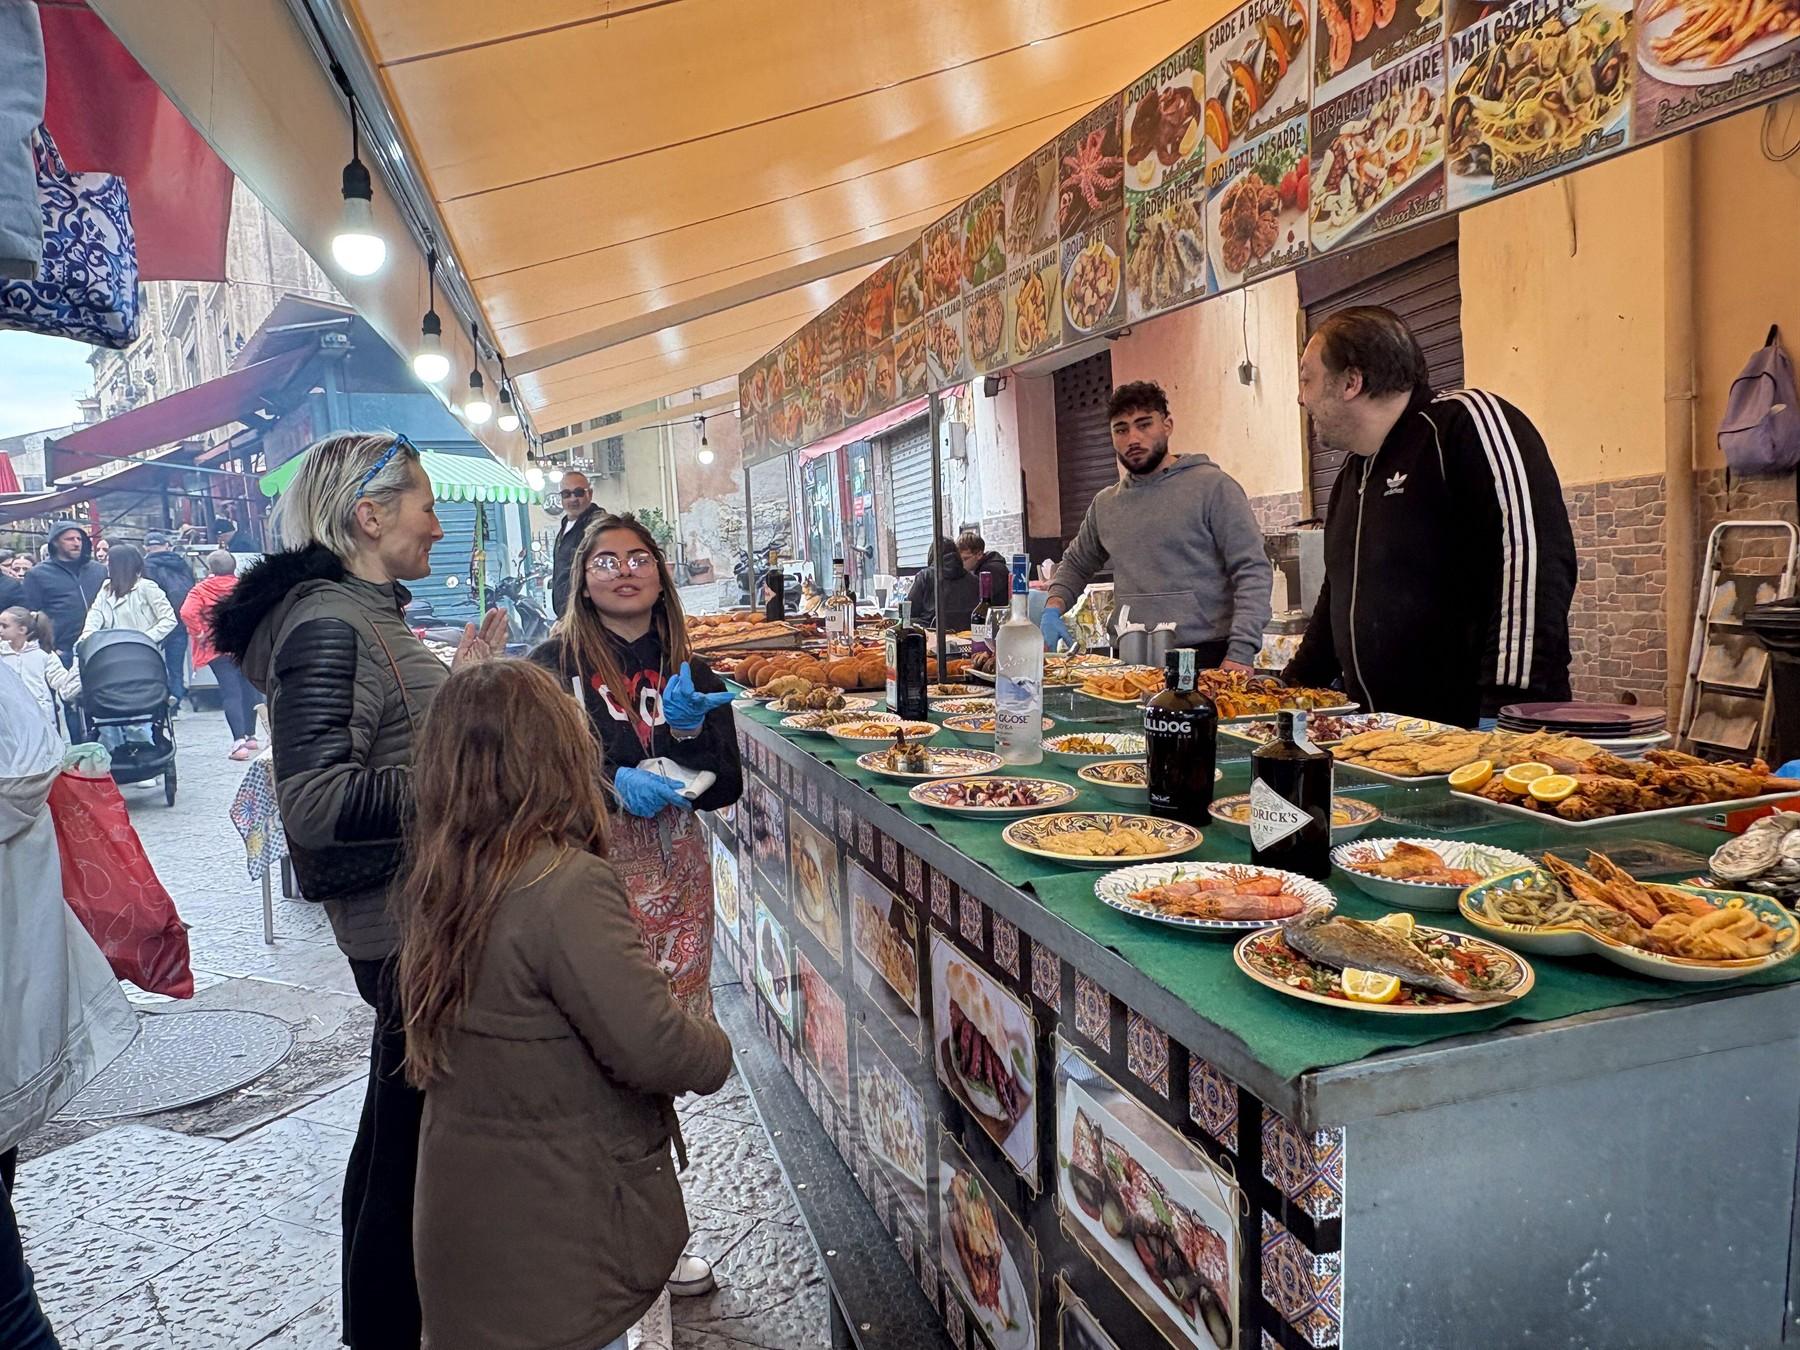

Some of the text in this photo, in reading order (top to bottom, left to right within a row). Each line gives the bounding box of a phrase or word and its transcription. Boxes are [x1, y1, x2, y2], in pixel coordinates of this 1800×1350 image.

[1209, 17, 1237, 53] SARDE
[1239, 10, 1246, 33] A
[1451, 22, 1489, 67] PASTA
[1128, 44, 1199, 106] POLPO BOLLITO
[1313, 84, 1374, 137] INSALATA
[1380, 77, 1393, 103] DI
[1399, 50, 1440, 92] MARE
[1211, 122, 1302, 186] POLPETTE DI SARDE
[1135, 196, 1163, 223] SARDE
[1164, 180, 1195, 210] FRITTE
